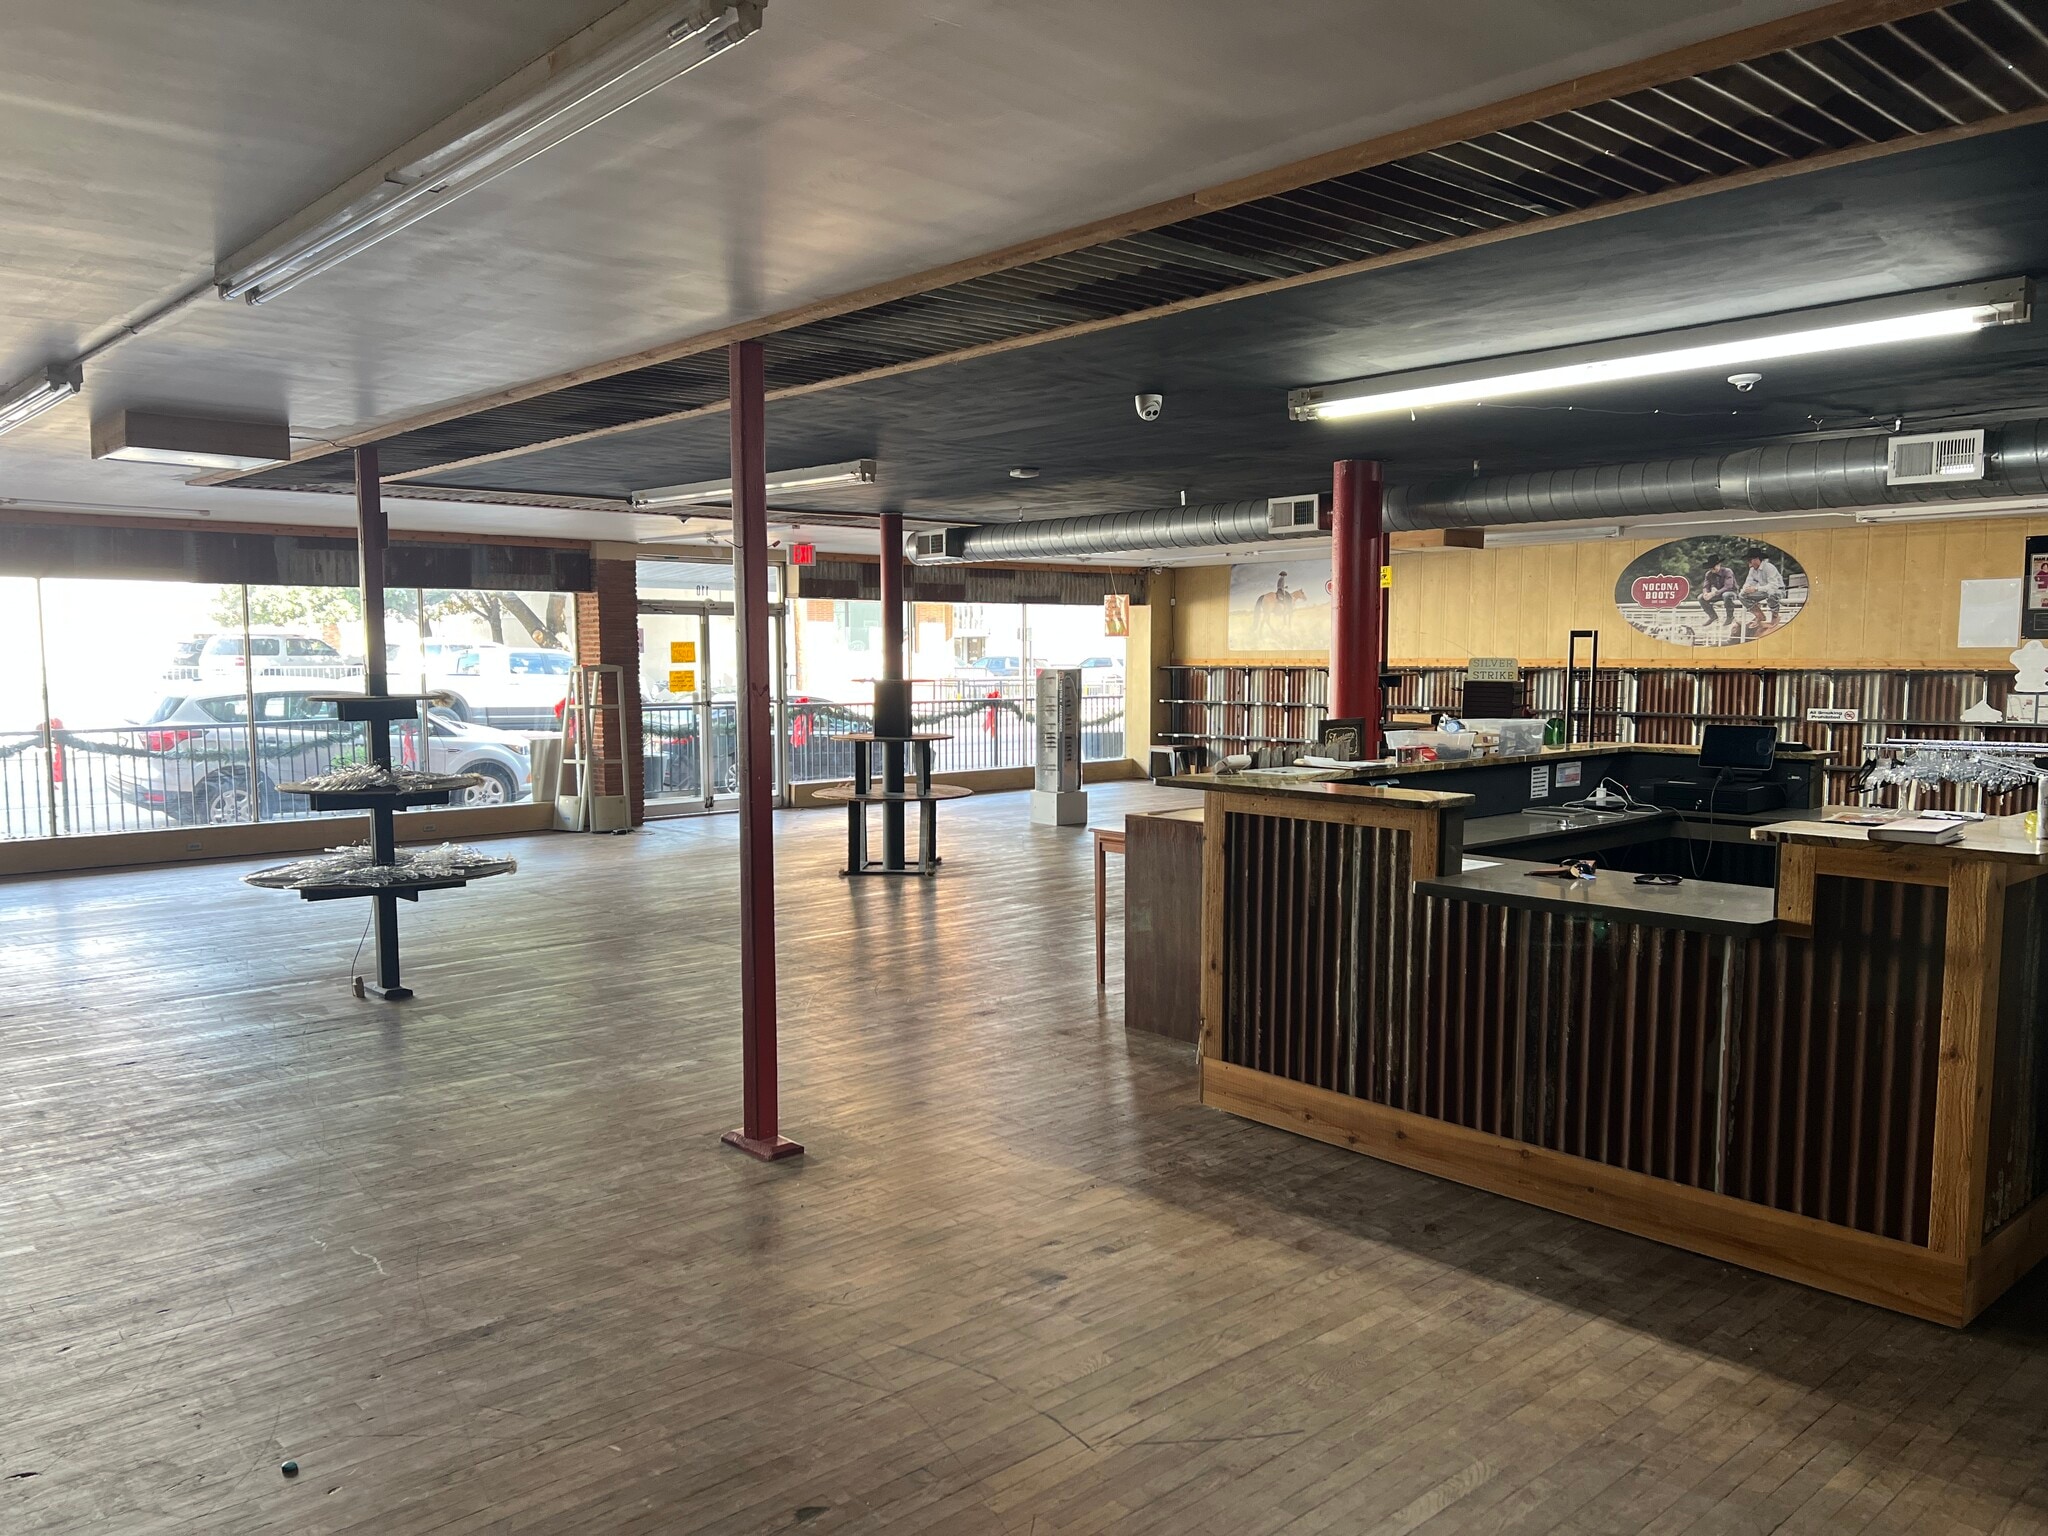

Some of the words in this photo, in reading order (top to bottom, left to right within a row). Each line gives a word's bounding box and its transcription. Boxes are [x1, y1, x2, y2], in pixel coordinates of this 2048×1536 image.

[793, 545, 813, 565] EXIT
[1642, 583, 1679, 591] NOCONA
[1645, 591, 1676, 599] BOOTS
[1473, 659, 1513, 668] SILVER
[1473, 671, 1514, 680] STRIKE
